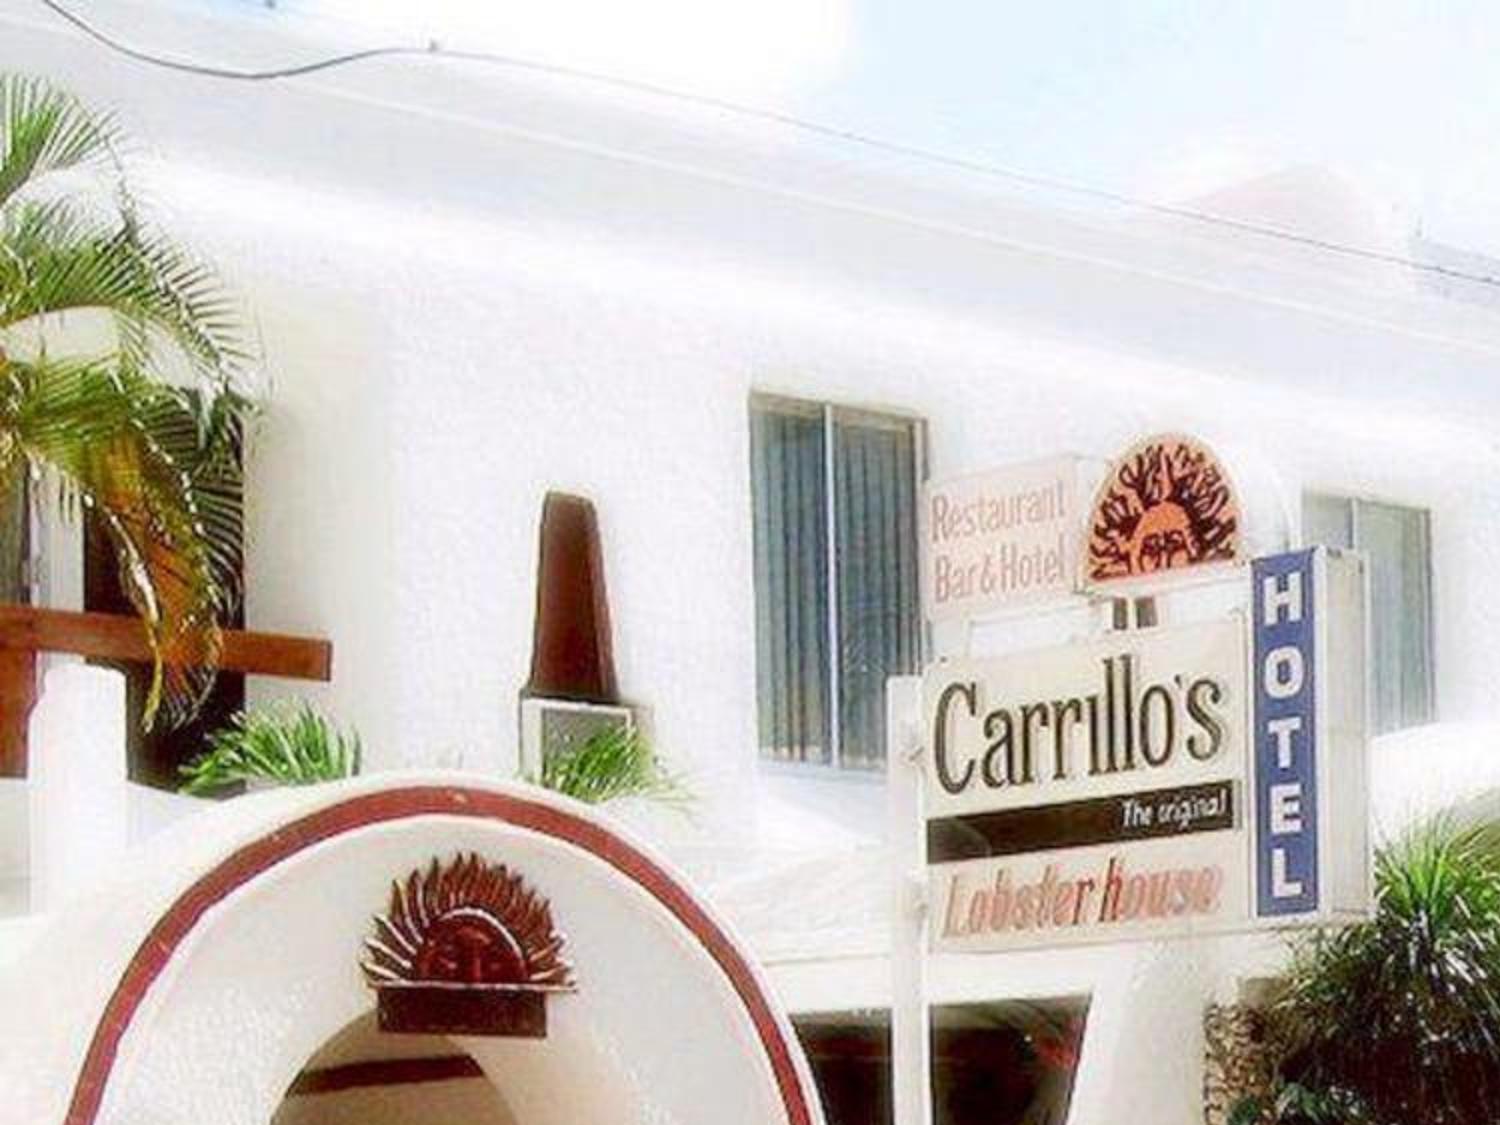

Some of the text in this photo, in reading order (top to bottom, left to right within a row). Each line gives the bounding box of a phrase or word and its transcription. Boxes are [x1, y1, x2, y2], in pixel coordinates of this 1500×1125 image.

[931, 481, 1066, 542] Restaurant
[934, 653, 1222, 795] Carrillo's
[1263, 570, 1304, 898] HOTEL
[1121, 788, 1227, 831] The original
